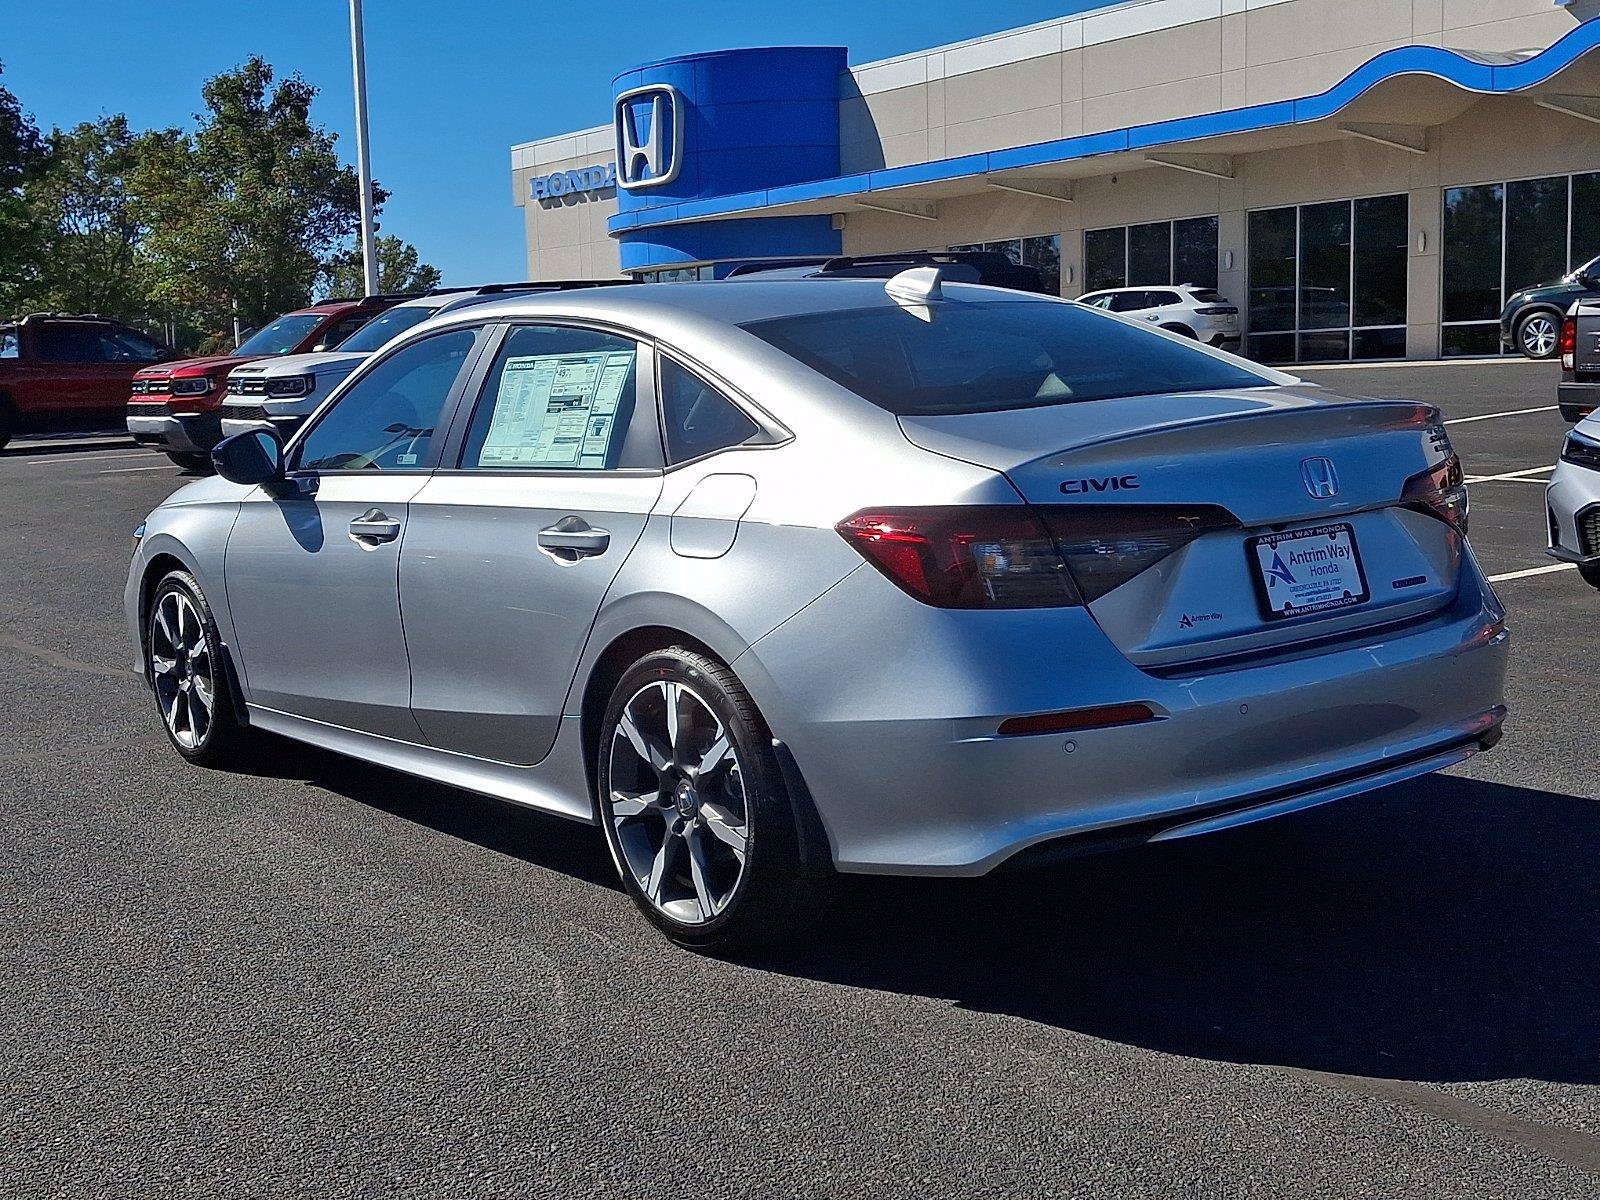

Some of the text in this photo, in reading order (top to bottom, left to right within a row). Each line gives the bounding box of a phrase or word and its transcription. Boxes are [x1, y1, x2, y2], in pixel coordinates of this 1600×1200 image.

[1059, 475, 1140, 494] CIVIC
[1258, 524, 1347, 544] ANTRIM WAY HONDA
[1288, 543, 1351, 566] Antrim Way
[1308, 561, 1340, 577] Honda
[1283, 596, 1358, 616] WWW.ANTRIMHONDA.COM
